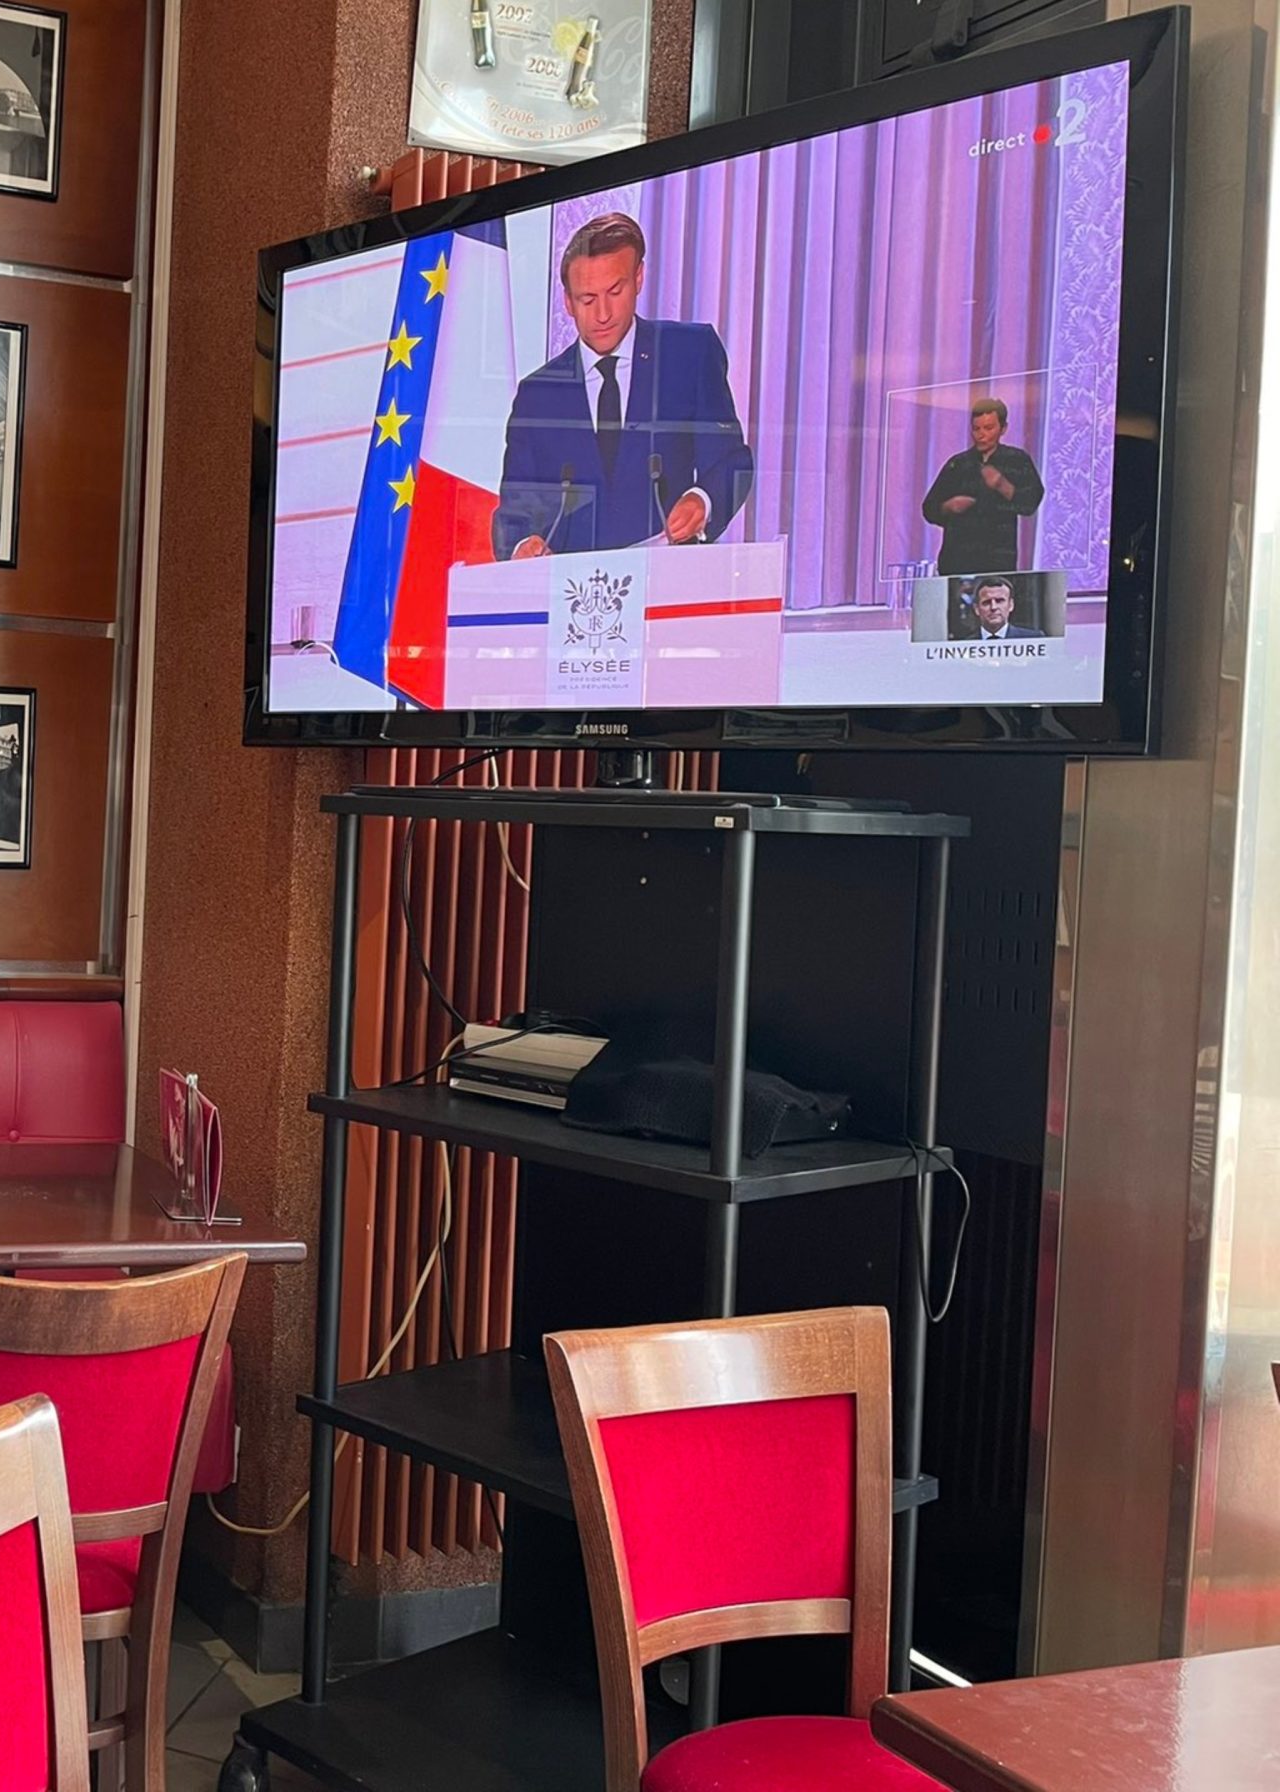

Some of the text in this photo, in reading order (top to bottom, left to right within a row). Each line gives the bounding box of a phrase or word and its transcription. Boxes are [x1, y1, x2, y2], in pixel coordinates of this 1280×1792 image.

[501, 106, 535, 123] 2006
[527, 129, 545, 140] ses
[549, 125, 573, 139] 120
[576, 113, 600, 134] ans
[968, 98, 1087, 157] direct 2
[926, 644, 1047, 660] L'INVESTITURE
[558, 659, 631, 674] ÉLYSÉE
[575, 723, 628, 735] SAMSUNG
